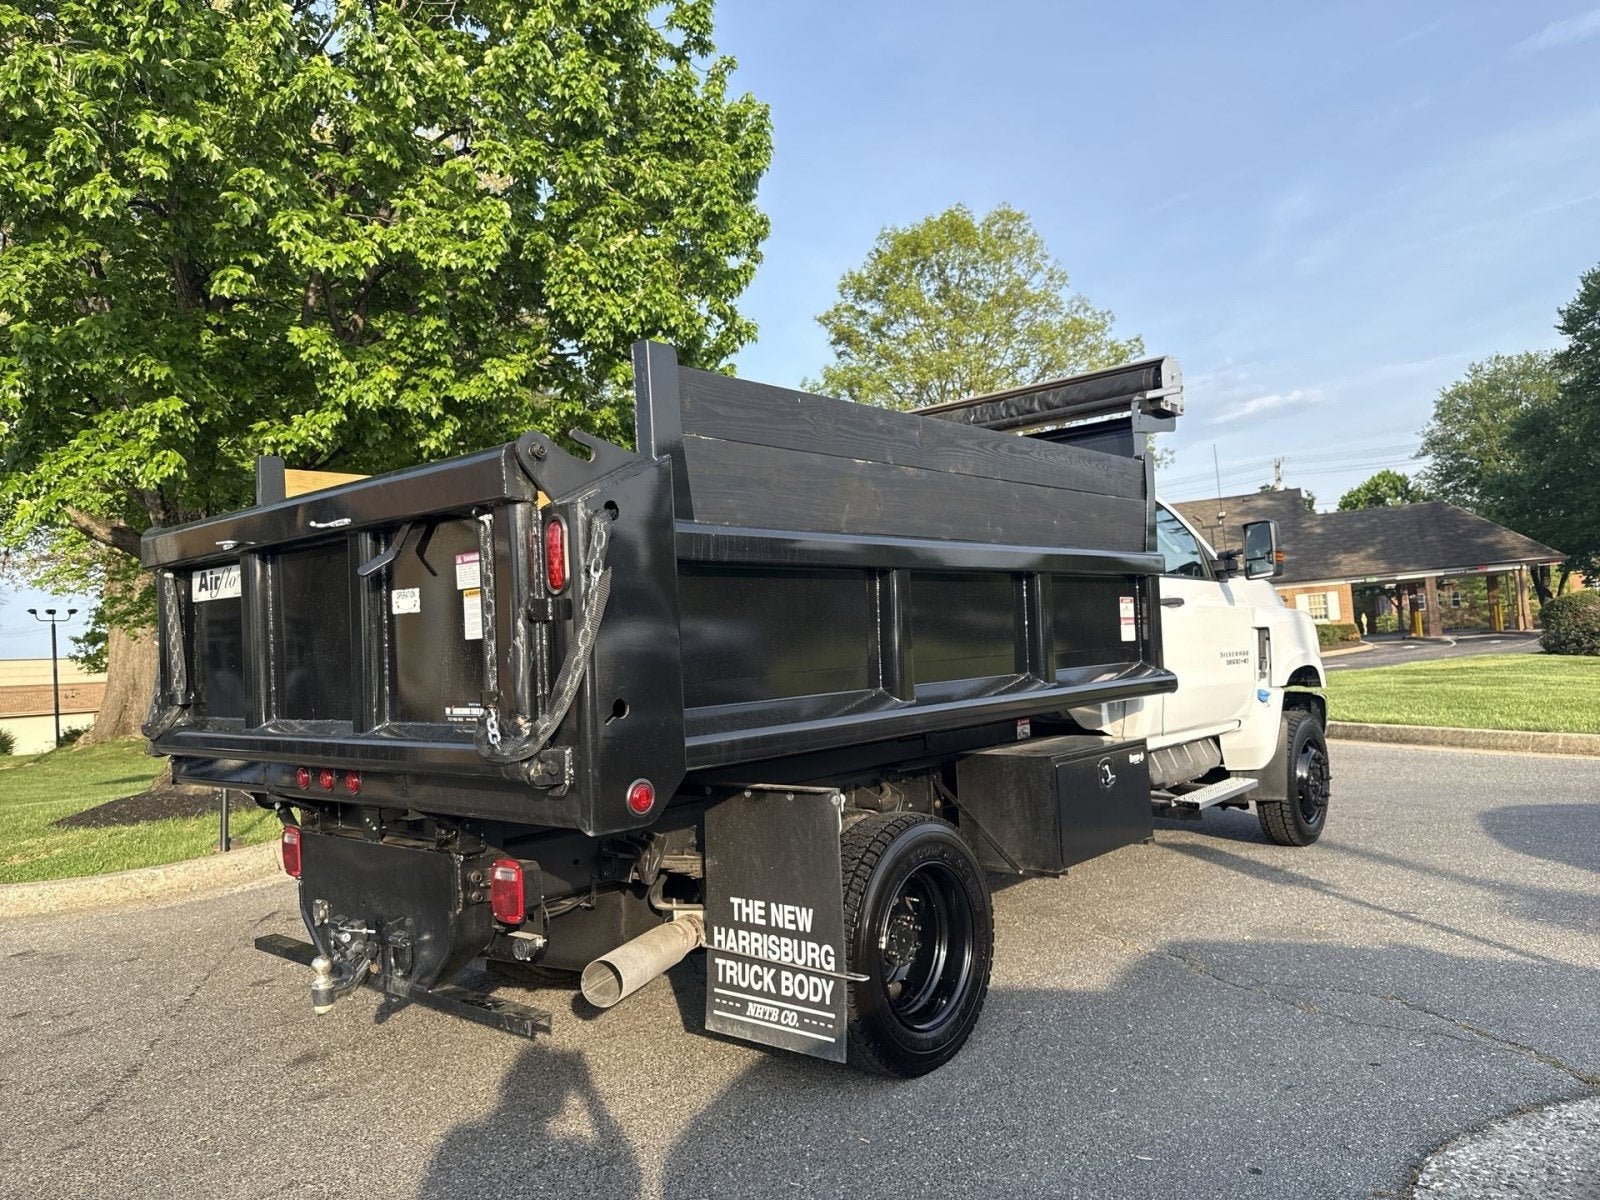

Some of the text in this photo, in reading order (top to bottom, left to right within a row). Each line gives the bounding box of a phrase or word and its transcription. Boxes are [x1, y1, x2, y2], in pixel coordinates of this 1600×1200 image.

[729, 896, 814, 933] THE NEW
[713, 925, 836, 972] HARRISBURG
[714, 957, 835, 1006] TRUCK BODY
[745, 1001, 800, 1028] NHTB CO.
